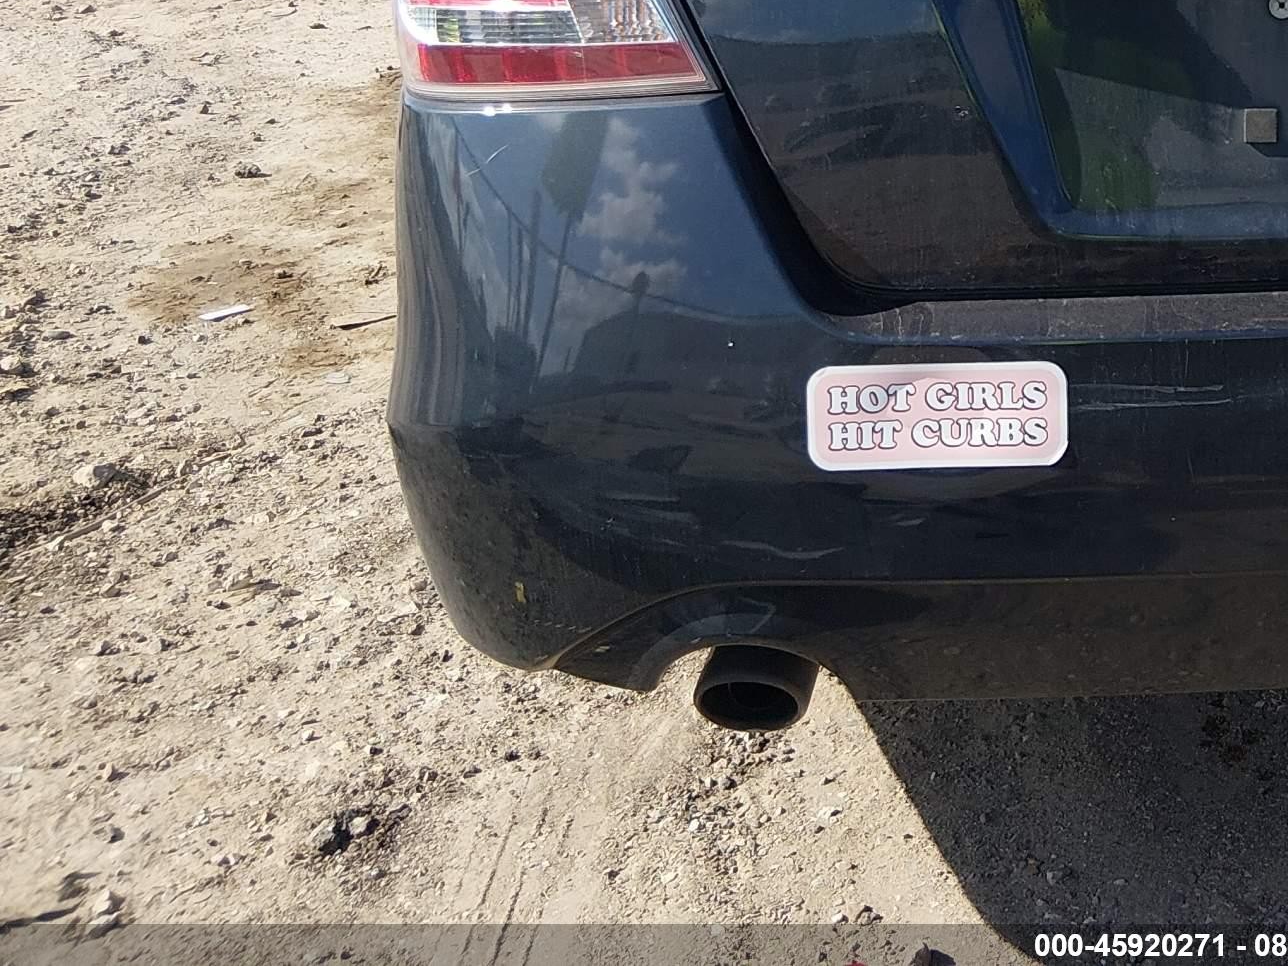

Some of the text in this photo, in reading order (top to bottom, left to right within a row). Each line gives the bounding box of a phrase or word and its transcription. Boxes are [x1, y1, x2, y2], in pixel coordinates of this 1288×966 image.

[827, 381, 1047, 415] HOT GIRLS
[828, 417, 1048, 451] HIT CURBS
